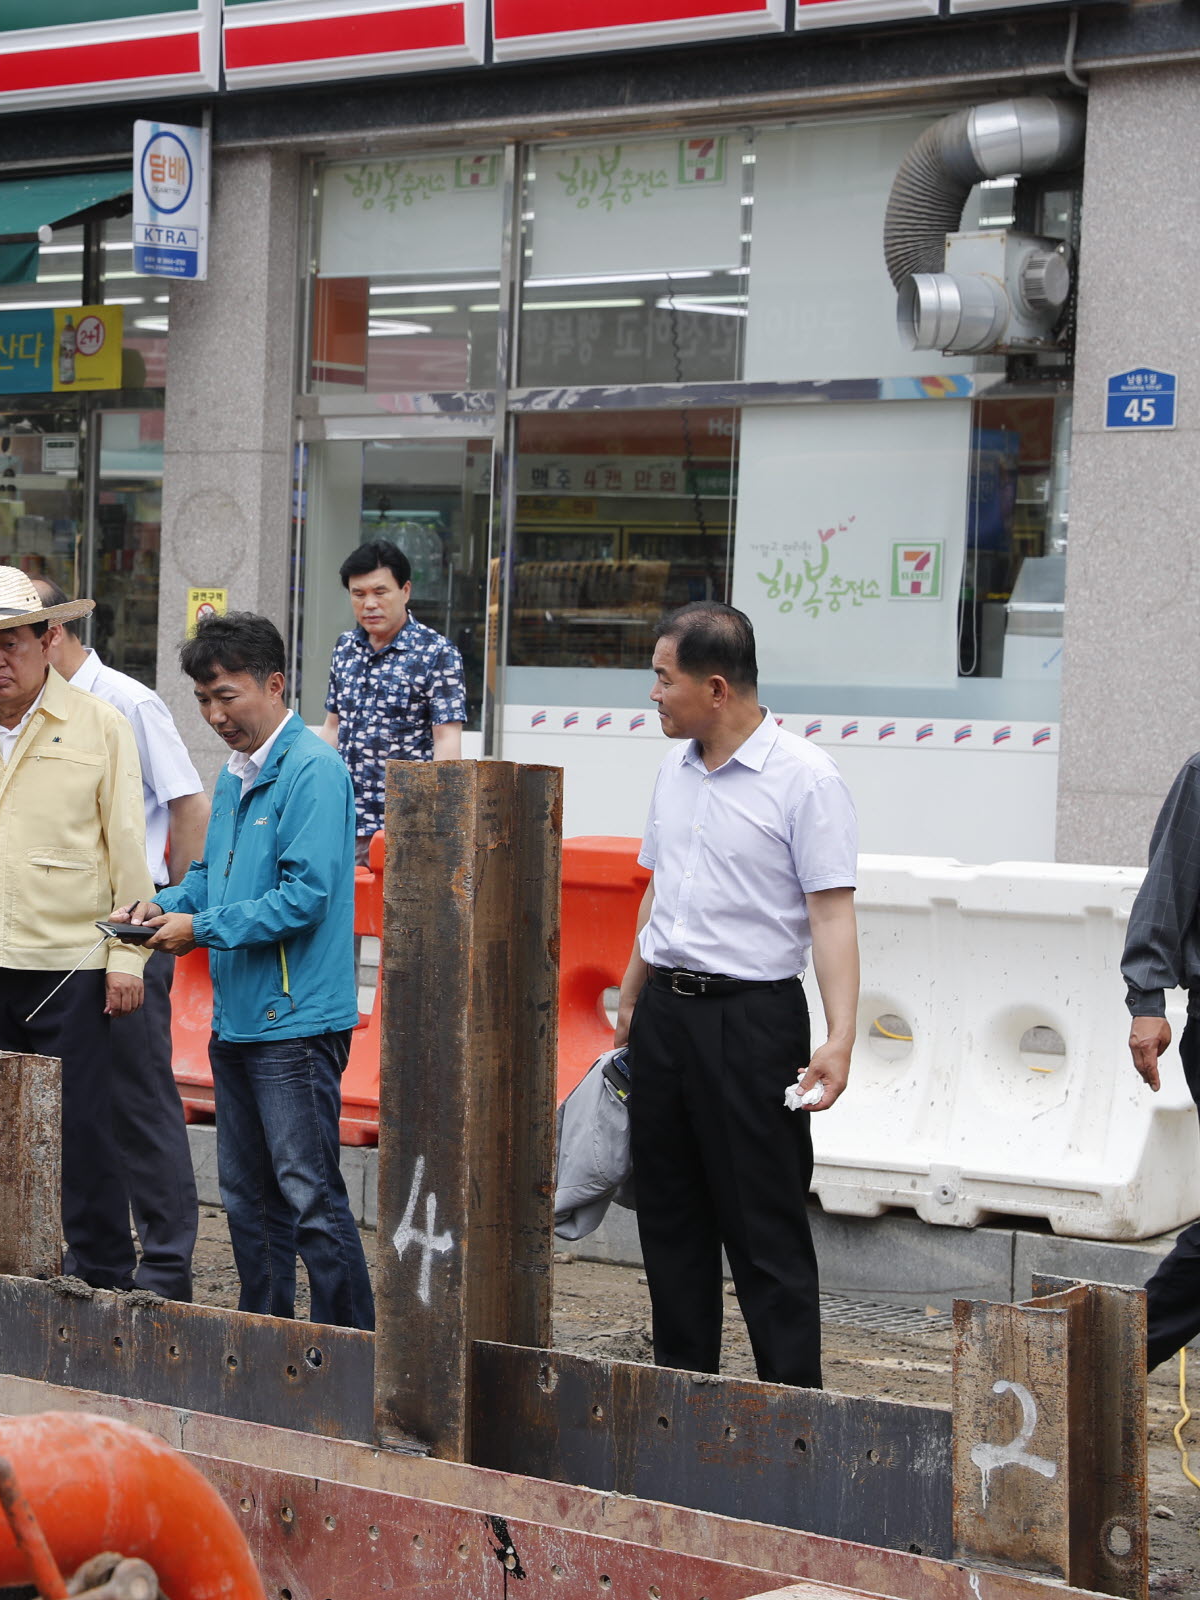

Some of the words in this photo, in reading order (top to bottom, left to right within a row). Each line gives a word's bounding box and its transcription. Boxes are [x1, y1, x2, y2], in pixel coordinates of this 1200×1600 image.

[149, 154, 186, 185] 담배
[144, 228, 187, 245] KTRA
[79, 325, 102, 347] 2+1
[1124, 398, 1156, 422] 45
[393, 1154, 453, 1306] 4
[971, 1379, 1058, 1480] 2
